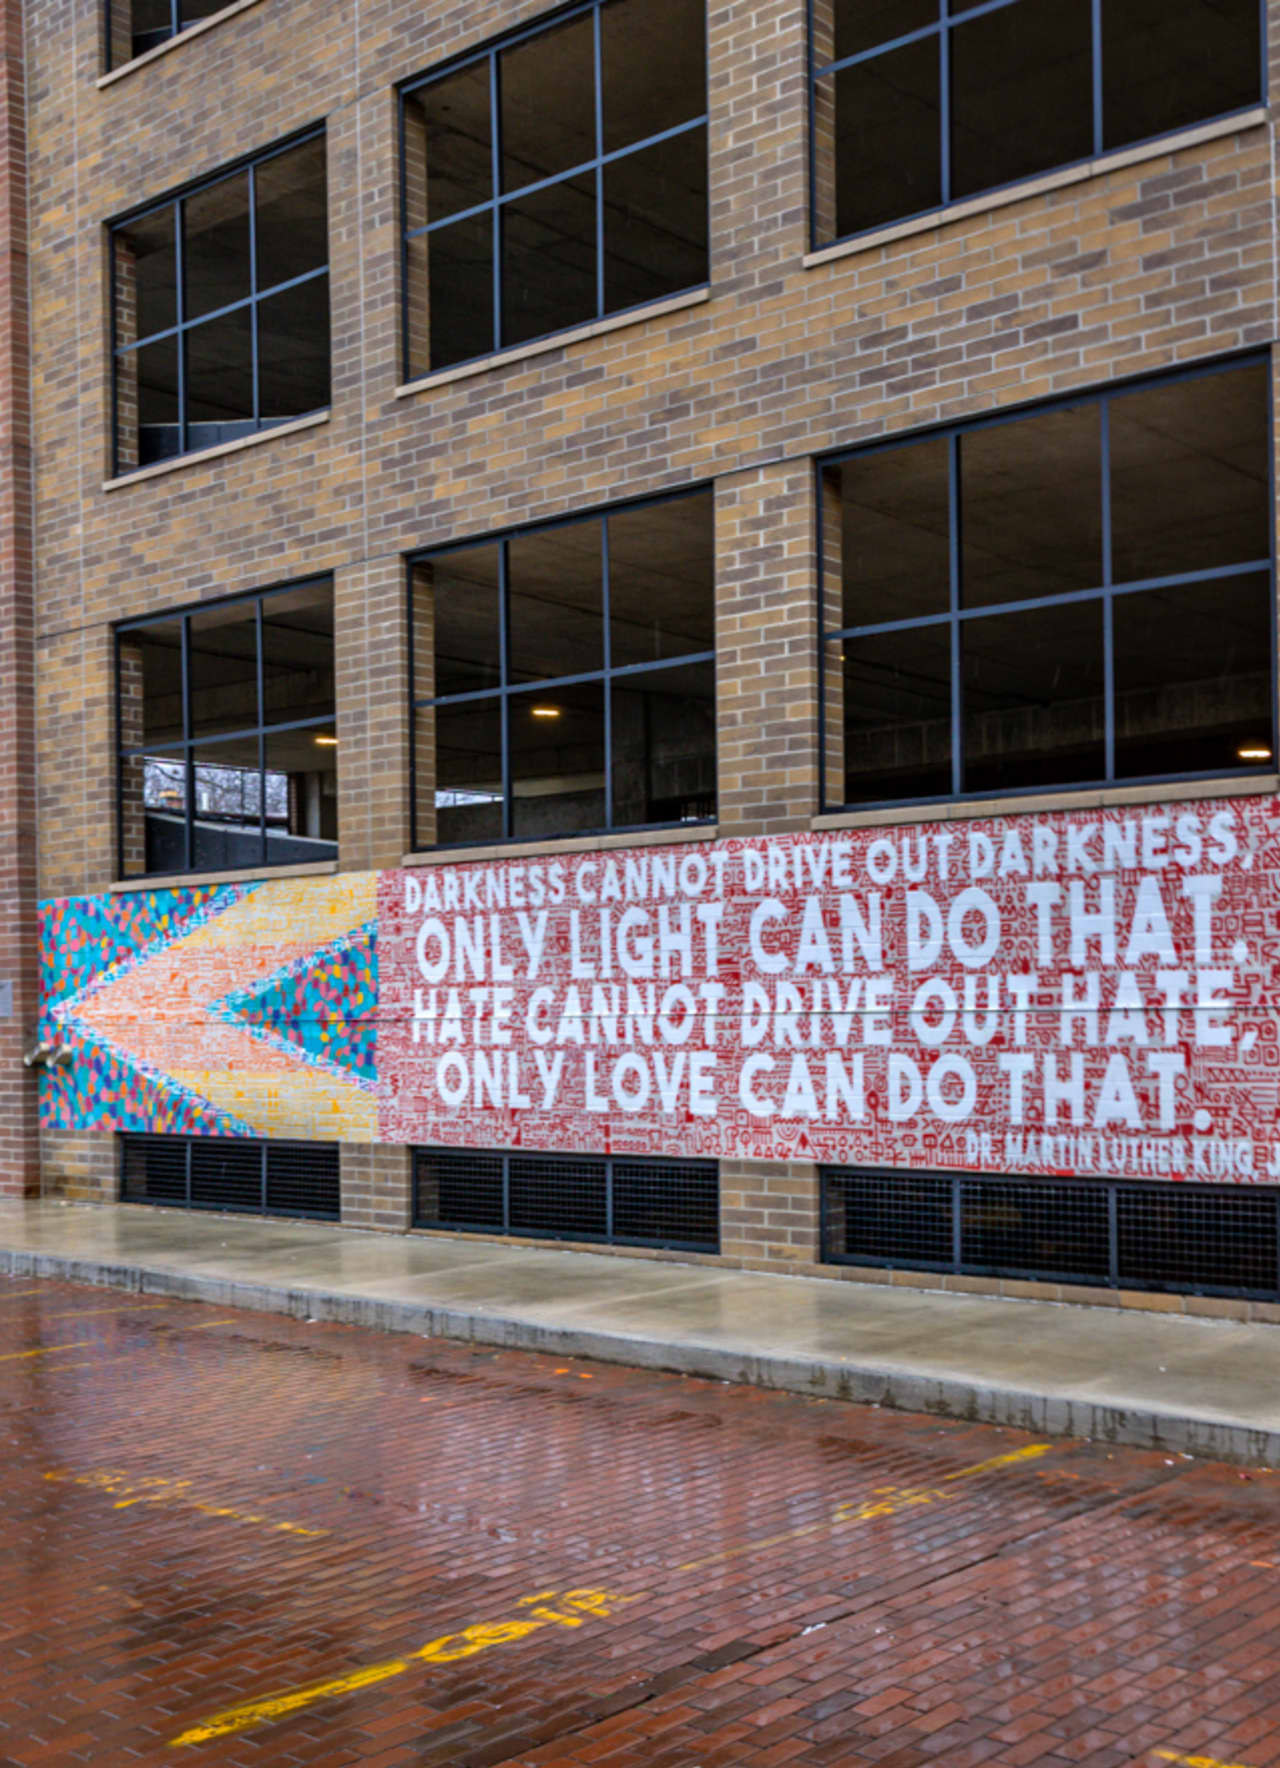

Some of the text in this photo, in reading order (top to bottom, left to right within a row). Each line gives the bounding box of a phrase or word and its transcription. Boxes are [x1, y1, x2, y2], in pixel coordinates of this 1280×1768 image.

[405, 812, 1254, 913] DARKNESS CANNOT DRIVE OUT DARKNESS,
[416, 876, 1249, 984] ONLY LIGHT CAN DO THAT.
[412, 969, 1257, 1050] HATE CANNOT DRIVE OUT HATE,
[436, 1051, 1213, 1130] ONLY LOVE CAN DO THAT.
[1005, 1130, 1096, 1170] MARTIN
[1100, 1134, 1188, 1174] LUTHER
